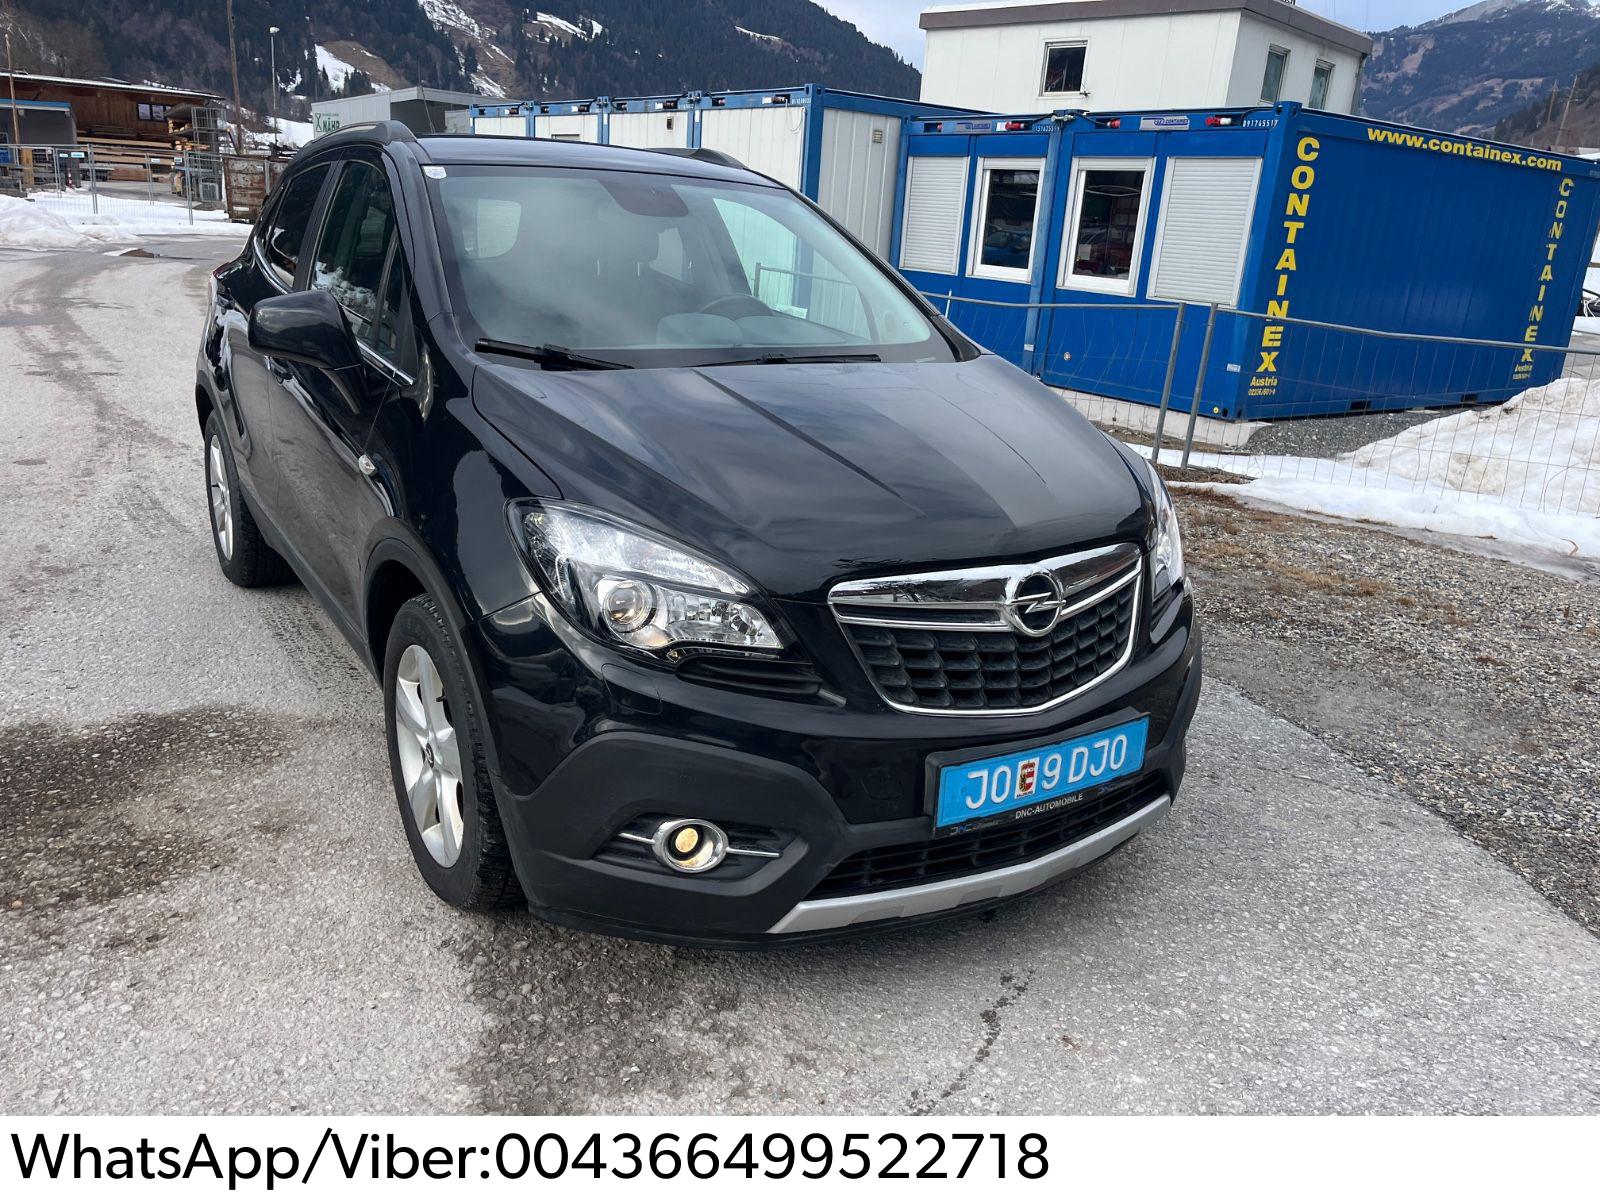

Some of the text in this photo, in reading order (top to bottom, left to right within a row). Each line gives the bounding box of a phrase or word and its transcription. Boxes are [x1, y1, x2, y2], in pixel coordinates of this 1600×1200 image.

[1367, 127, 1562, 172] www.containex.com
[1256, 137, 1320, 373] CONTAINEX
[1521, 178, 1575, 362] CONTAINEX
[1249, 375, 1278, 387] Austria
[965, 733, 1128, 810] JO 9 DJO
[1015, 792, 1084, 820] DNC-AUTOMOBILE
